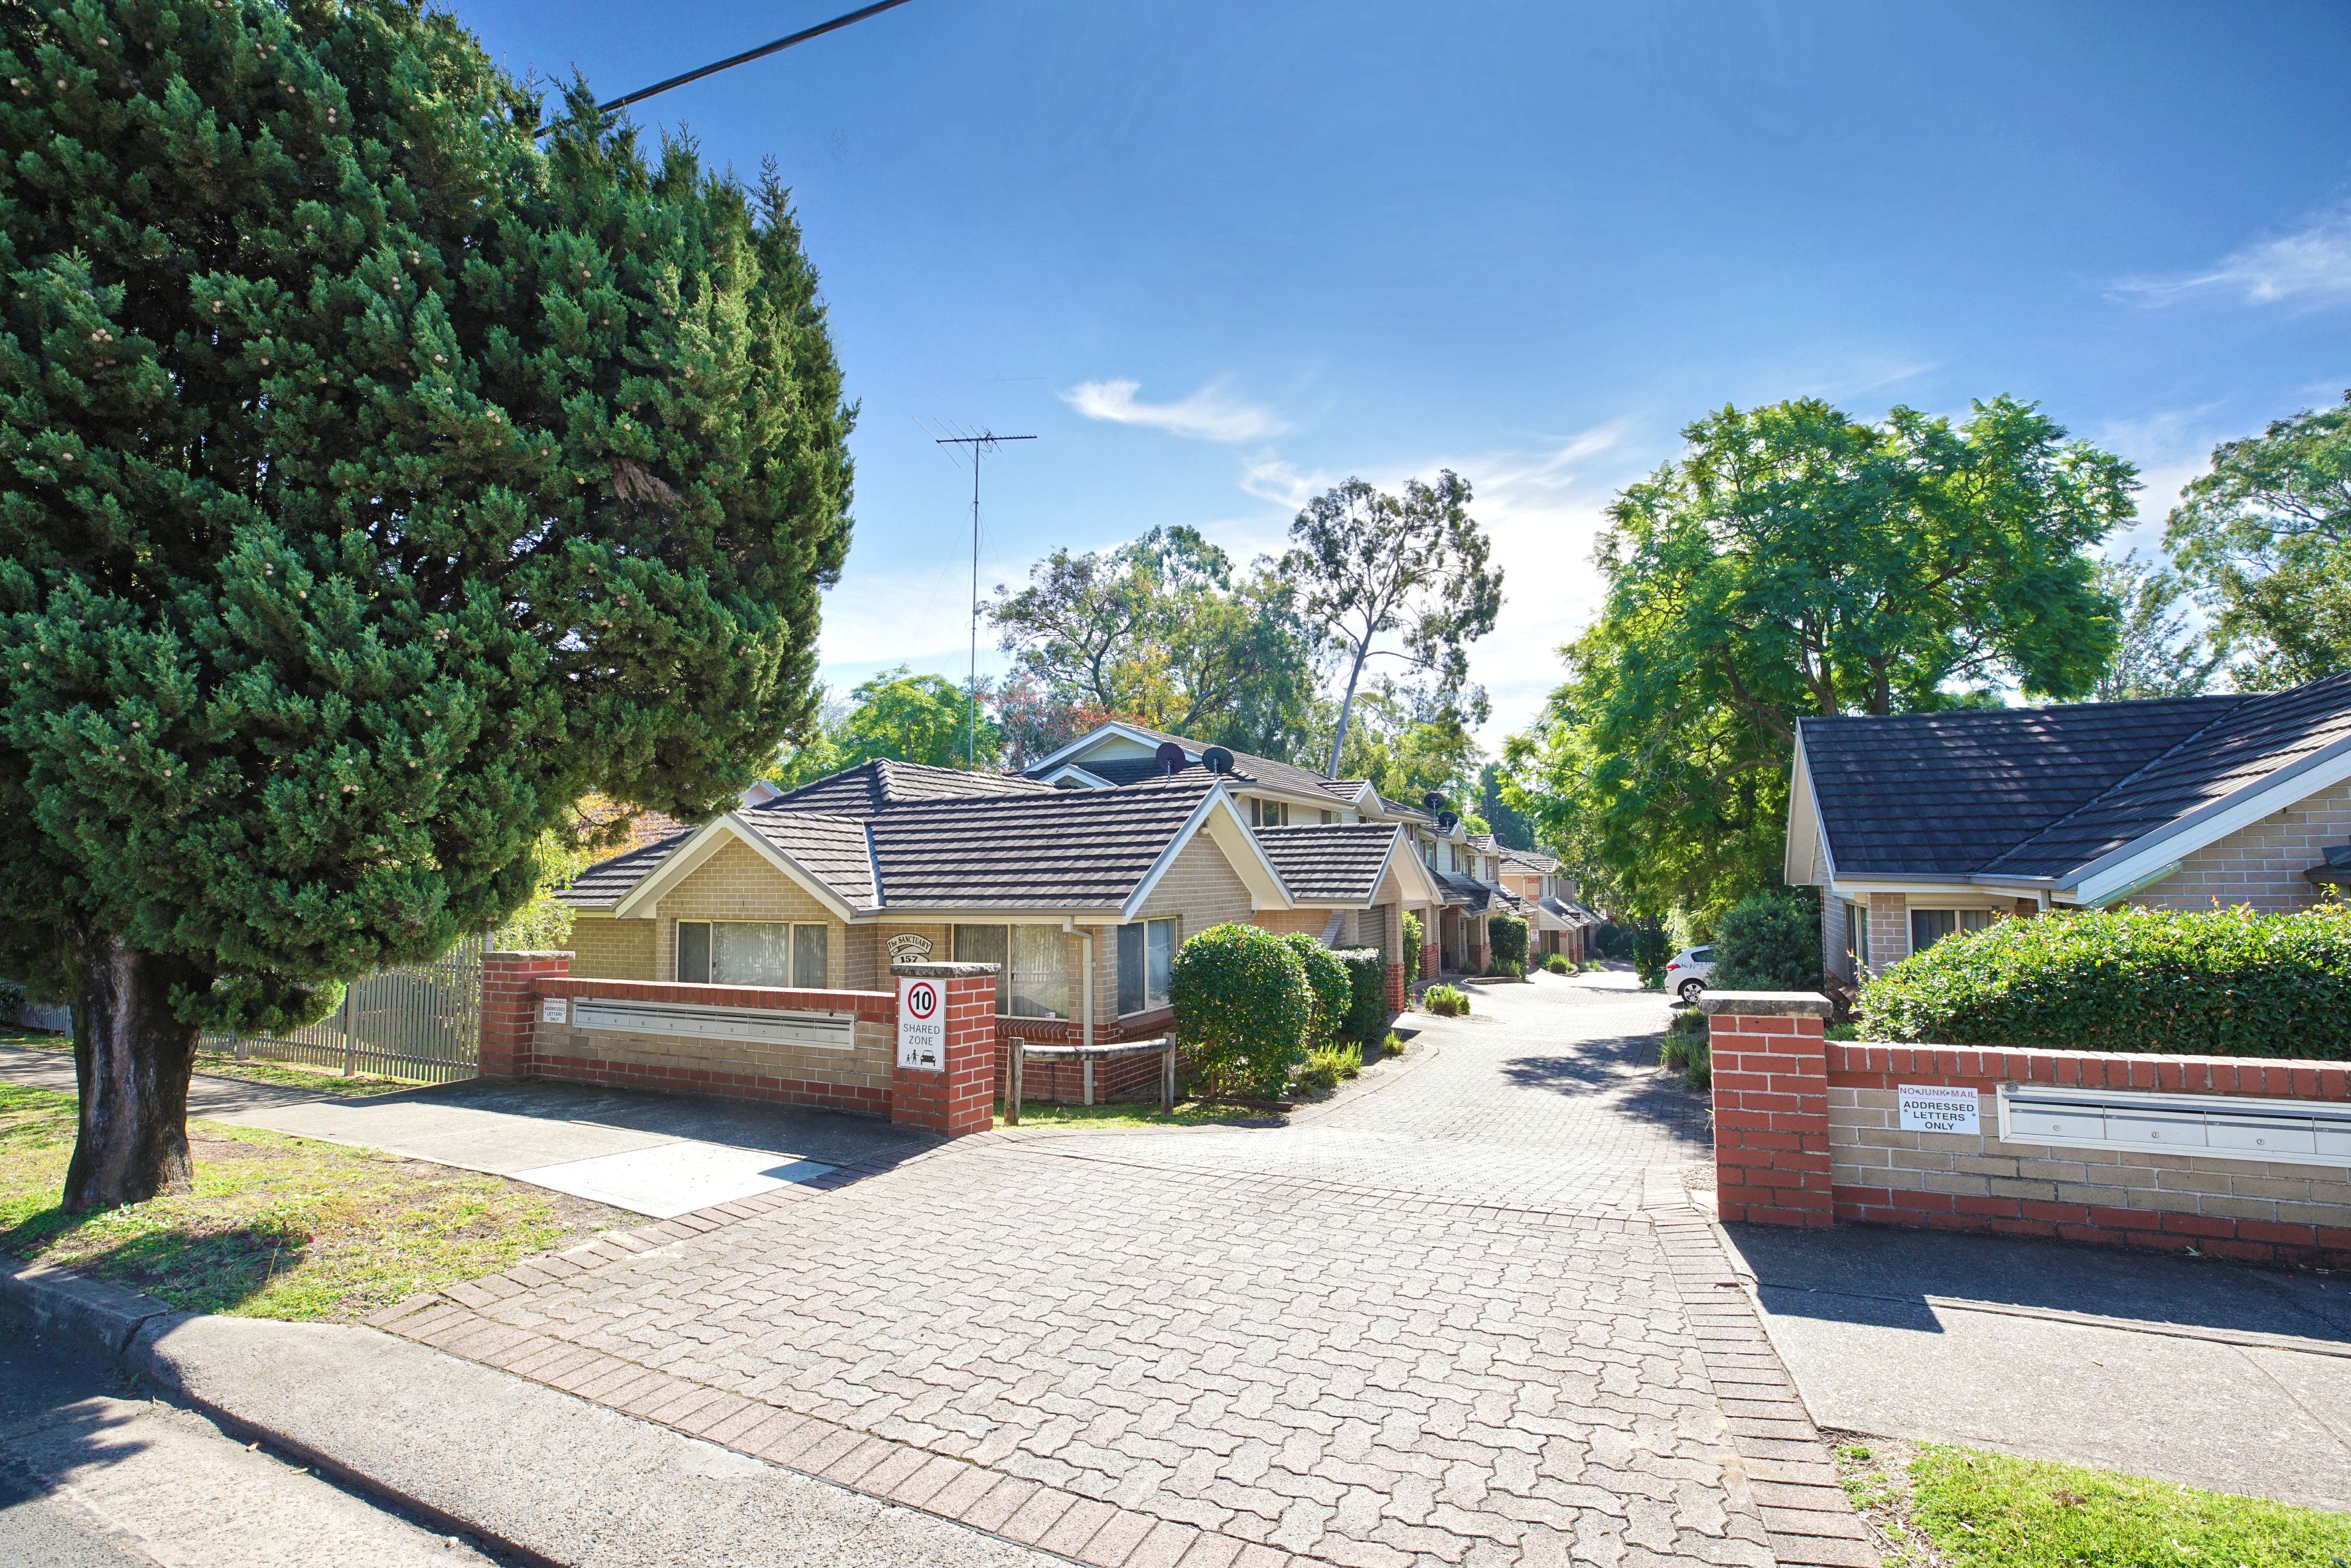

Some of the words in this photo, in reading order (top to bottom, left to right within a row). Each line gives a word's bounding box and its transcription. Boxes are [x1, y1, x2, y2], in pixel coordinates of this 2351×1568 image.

[888, 940, 897, 949] The
[898, 936, 931, 950] SANCTUARY
[913, 991, 932, 1011] 10
[903, 1023, 940, 1034] SHARED
[908, 1036, 934, 1046] ZONE
[1918, 1088, 1947, 1097] JUNK
[1951, 1090, 1977, 1098] MAIL
[1903, 1101, 1974, 1111] ADDRESSED
[1913, 1111, 1965, 1121] LETTERS
[1925, 1121, 1954, 1130] ONLY
